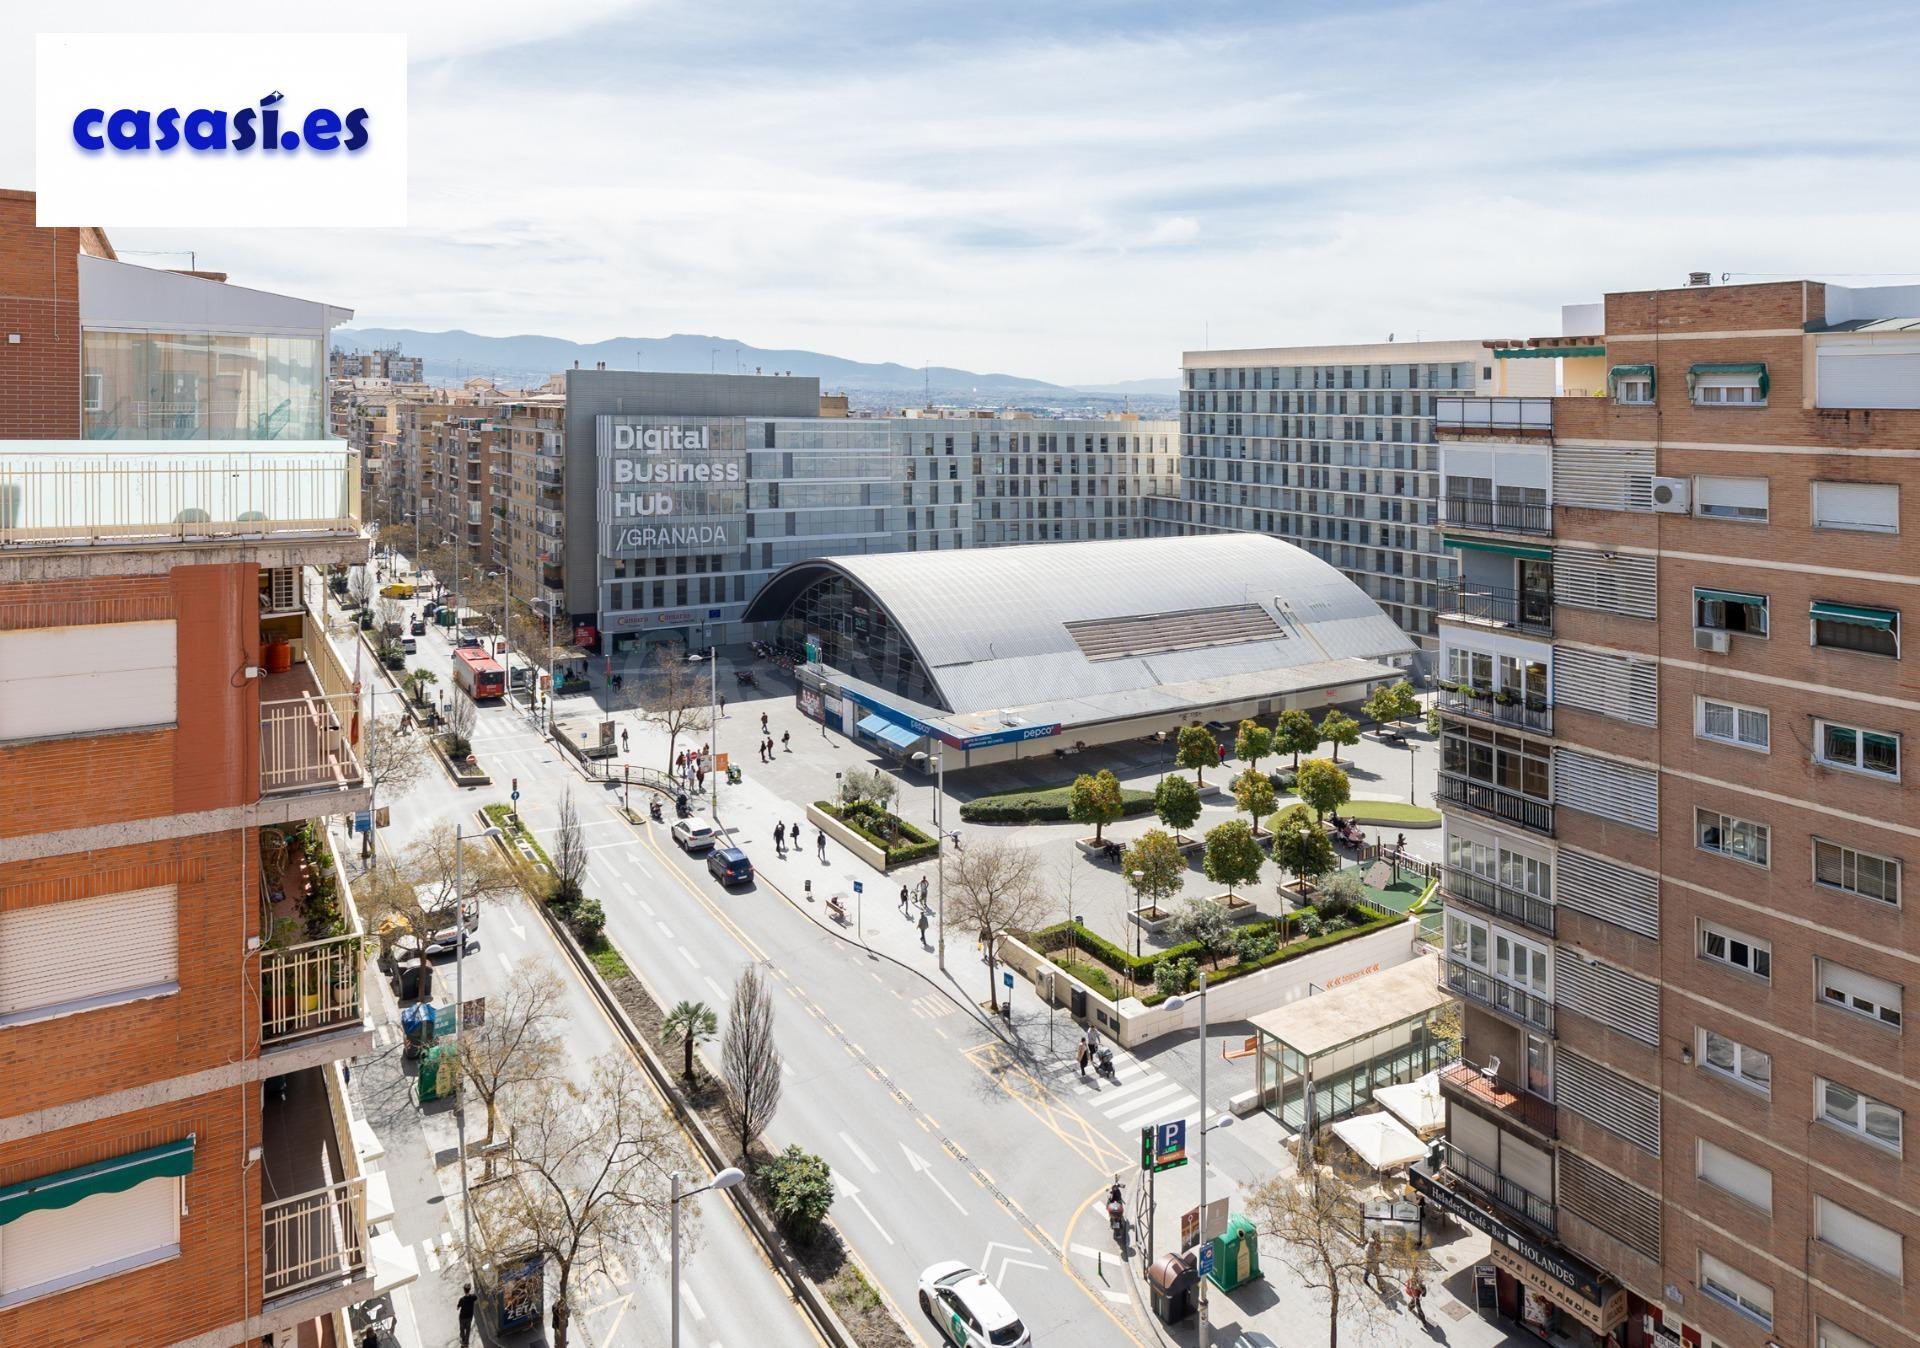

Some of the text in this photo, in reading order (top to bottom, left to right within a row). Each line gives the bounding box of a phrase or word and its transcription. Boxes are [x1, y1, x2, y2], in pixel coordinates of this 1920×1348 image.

[615, 425, 709, 454] Digital
[615, 458, 739, 482] Business
[615, 492, 673, 516] Hub
[1165, 1123, 1179, 1147] P
[1520, 1241, 1576, 1286] HOLANDES
[1493, 1248, 1523, 1272] CAFE
[1531, 1273, 1600, 1323] HOLANDES
